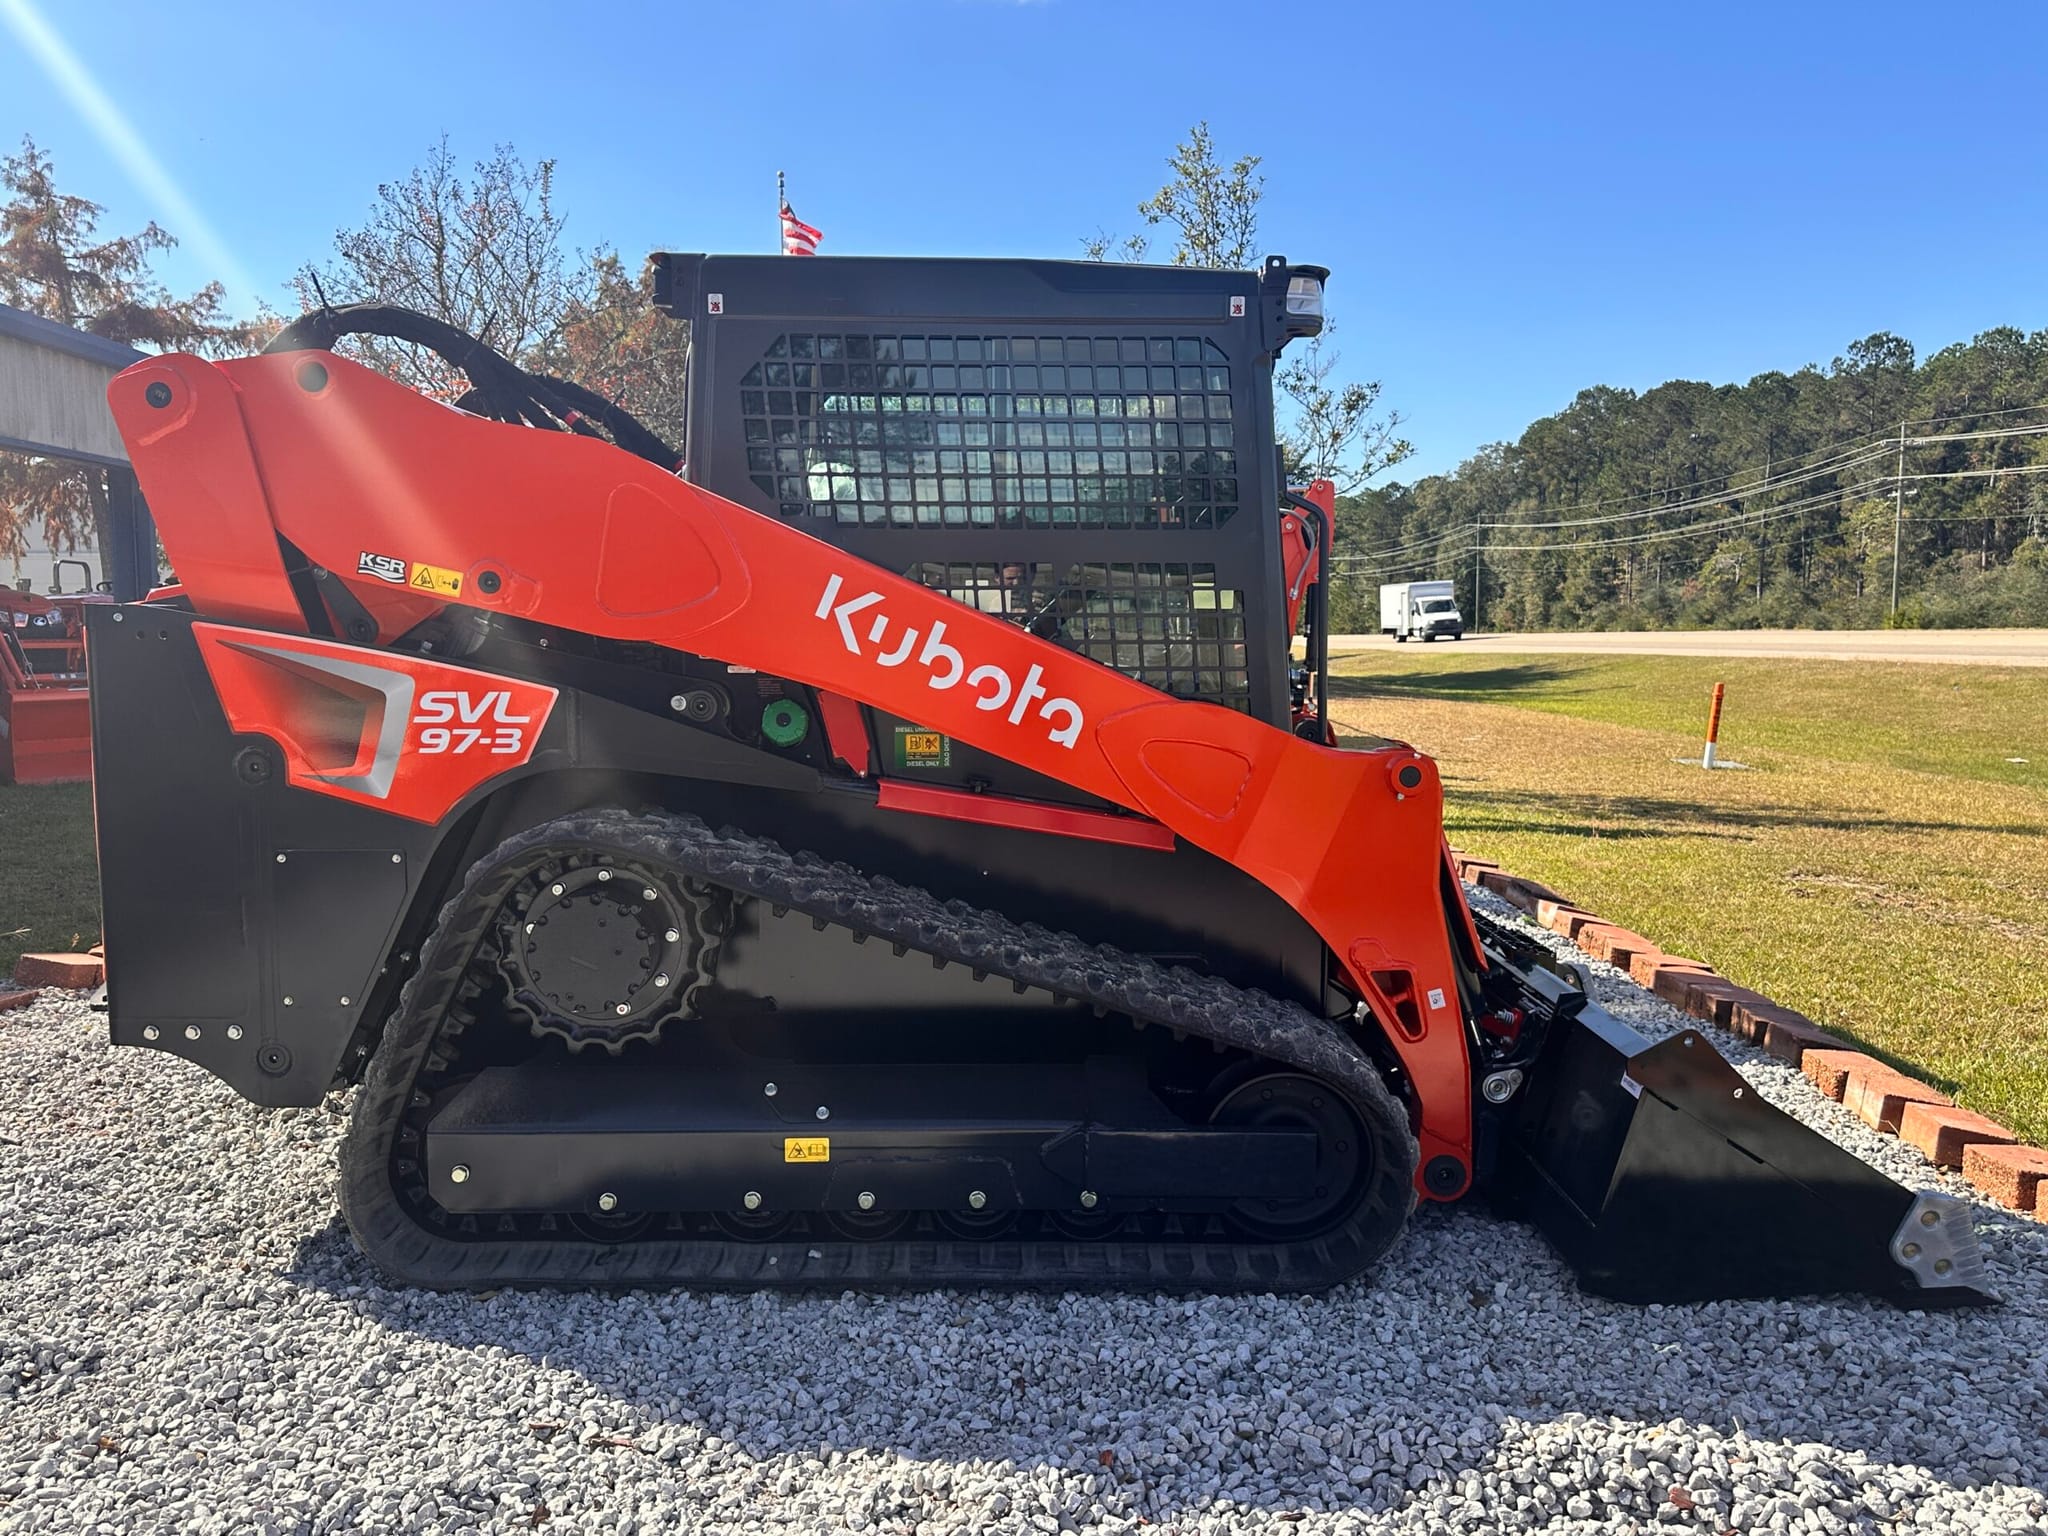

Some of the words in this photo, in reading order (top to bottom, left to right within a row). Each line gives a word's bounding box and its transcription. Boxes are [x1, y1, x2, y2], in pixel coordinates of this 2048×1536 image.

[359, 552, 406, 574] KSR
[815, 573, 1084, 749] Kubota
[413, 691, 531, 723] SVL
[419, 728, 522, 754] 97-3
